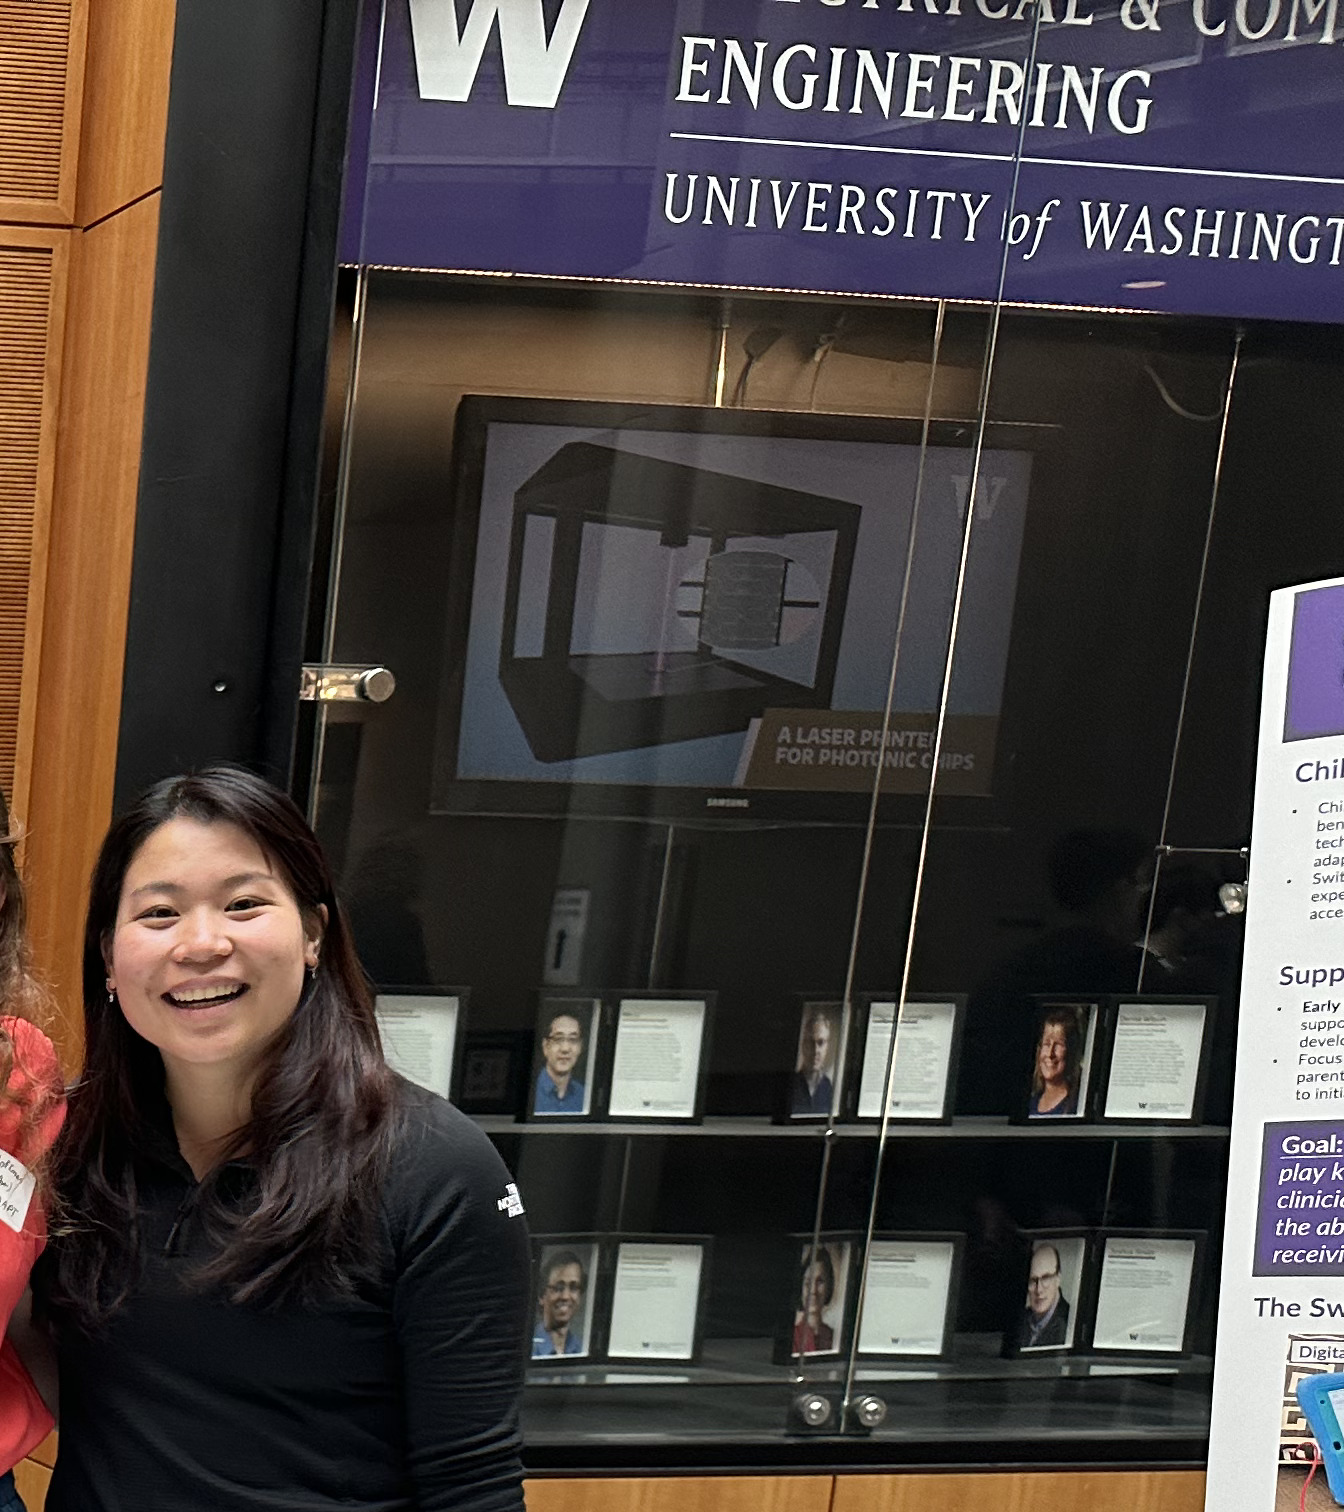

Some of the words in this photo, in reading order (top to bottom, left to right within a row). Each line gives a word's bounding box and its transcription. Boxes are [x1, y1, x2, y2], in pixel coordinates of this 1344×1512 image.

[407, 0, 589, 109] W
[675, 36, 1153, 134] ENGINEERING
[664, 171, 992, 245] UNIVERSITY
[1007, 199, 1061, 261] of
[1080, 200, 1344, 266] WASHINGT
[778, 726, 791, 743] A
[796, 728, 855, 745] LASER
[776, 748, 812, 764] FOR
[819, 750, 916, 768] PHOTONIC
[1303, 1000, 1341, 1014] Early
[1299, 1053, 1343, 1065] Focus
[1281, 1134, 1343, 1155] Goal:
[1278, 1162, 1326, 1185] play
[1275, 1218, 1311, 1236] the
[1254, 1297, 1300, 1317] The
